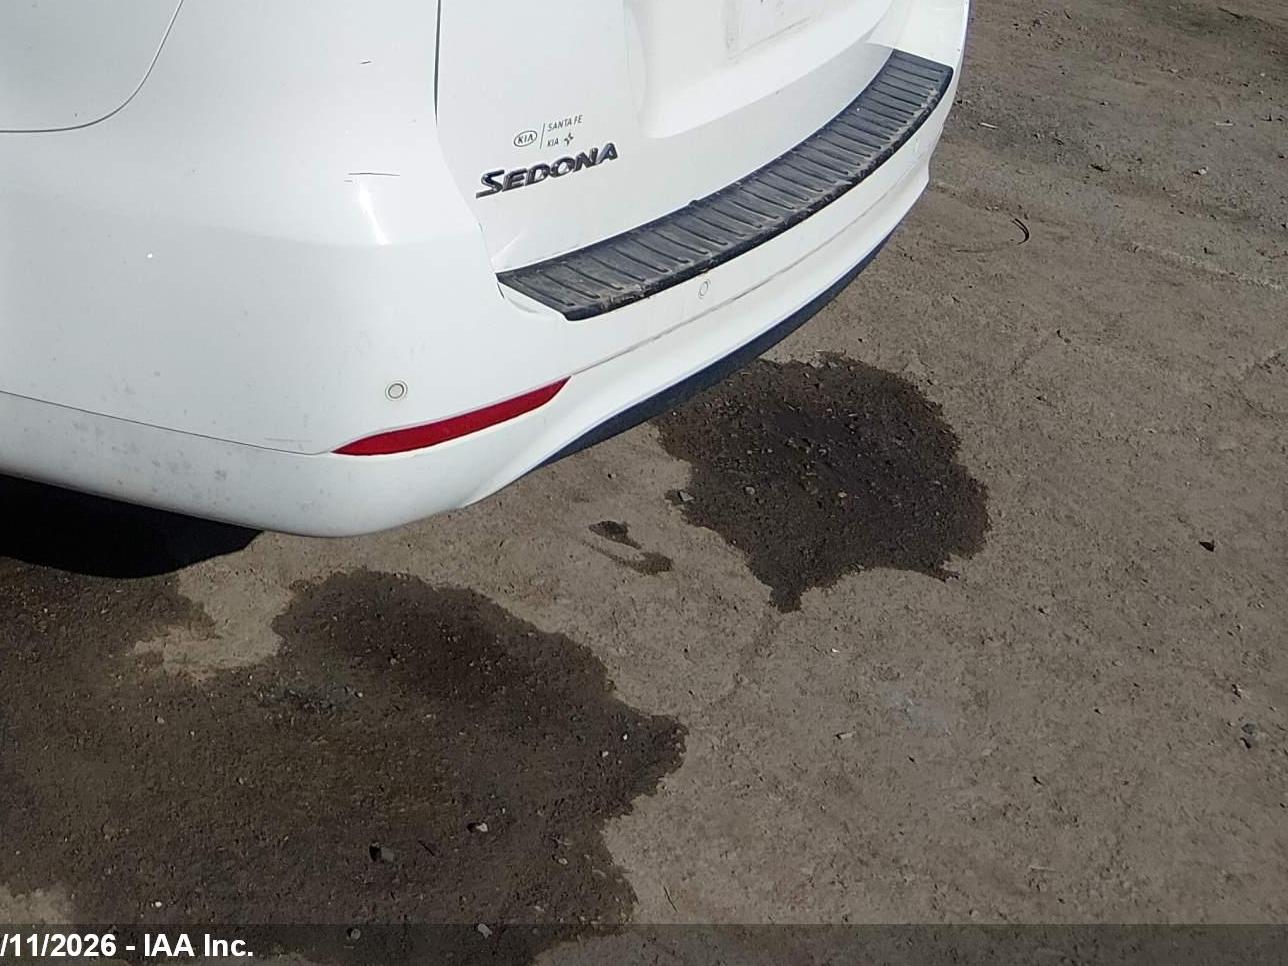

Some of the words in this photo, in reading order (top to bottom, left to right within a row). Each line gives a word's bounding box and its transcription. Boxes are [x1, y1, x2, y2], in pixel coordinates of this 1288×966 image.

[547, 118, 572, 132] SANTA
[574, 114, 583, 125] FE
[475, 141, 618, 199] SEDONA
